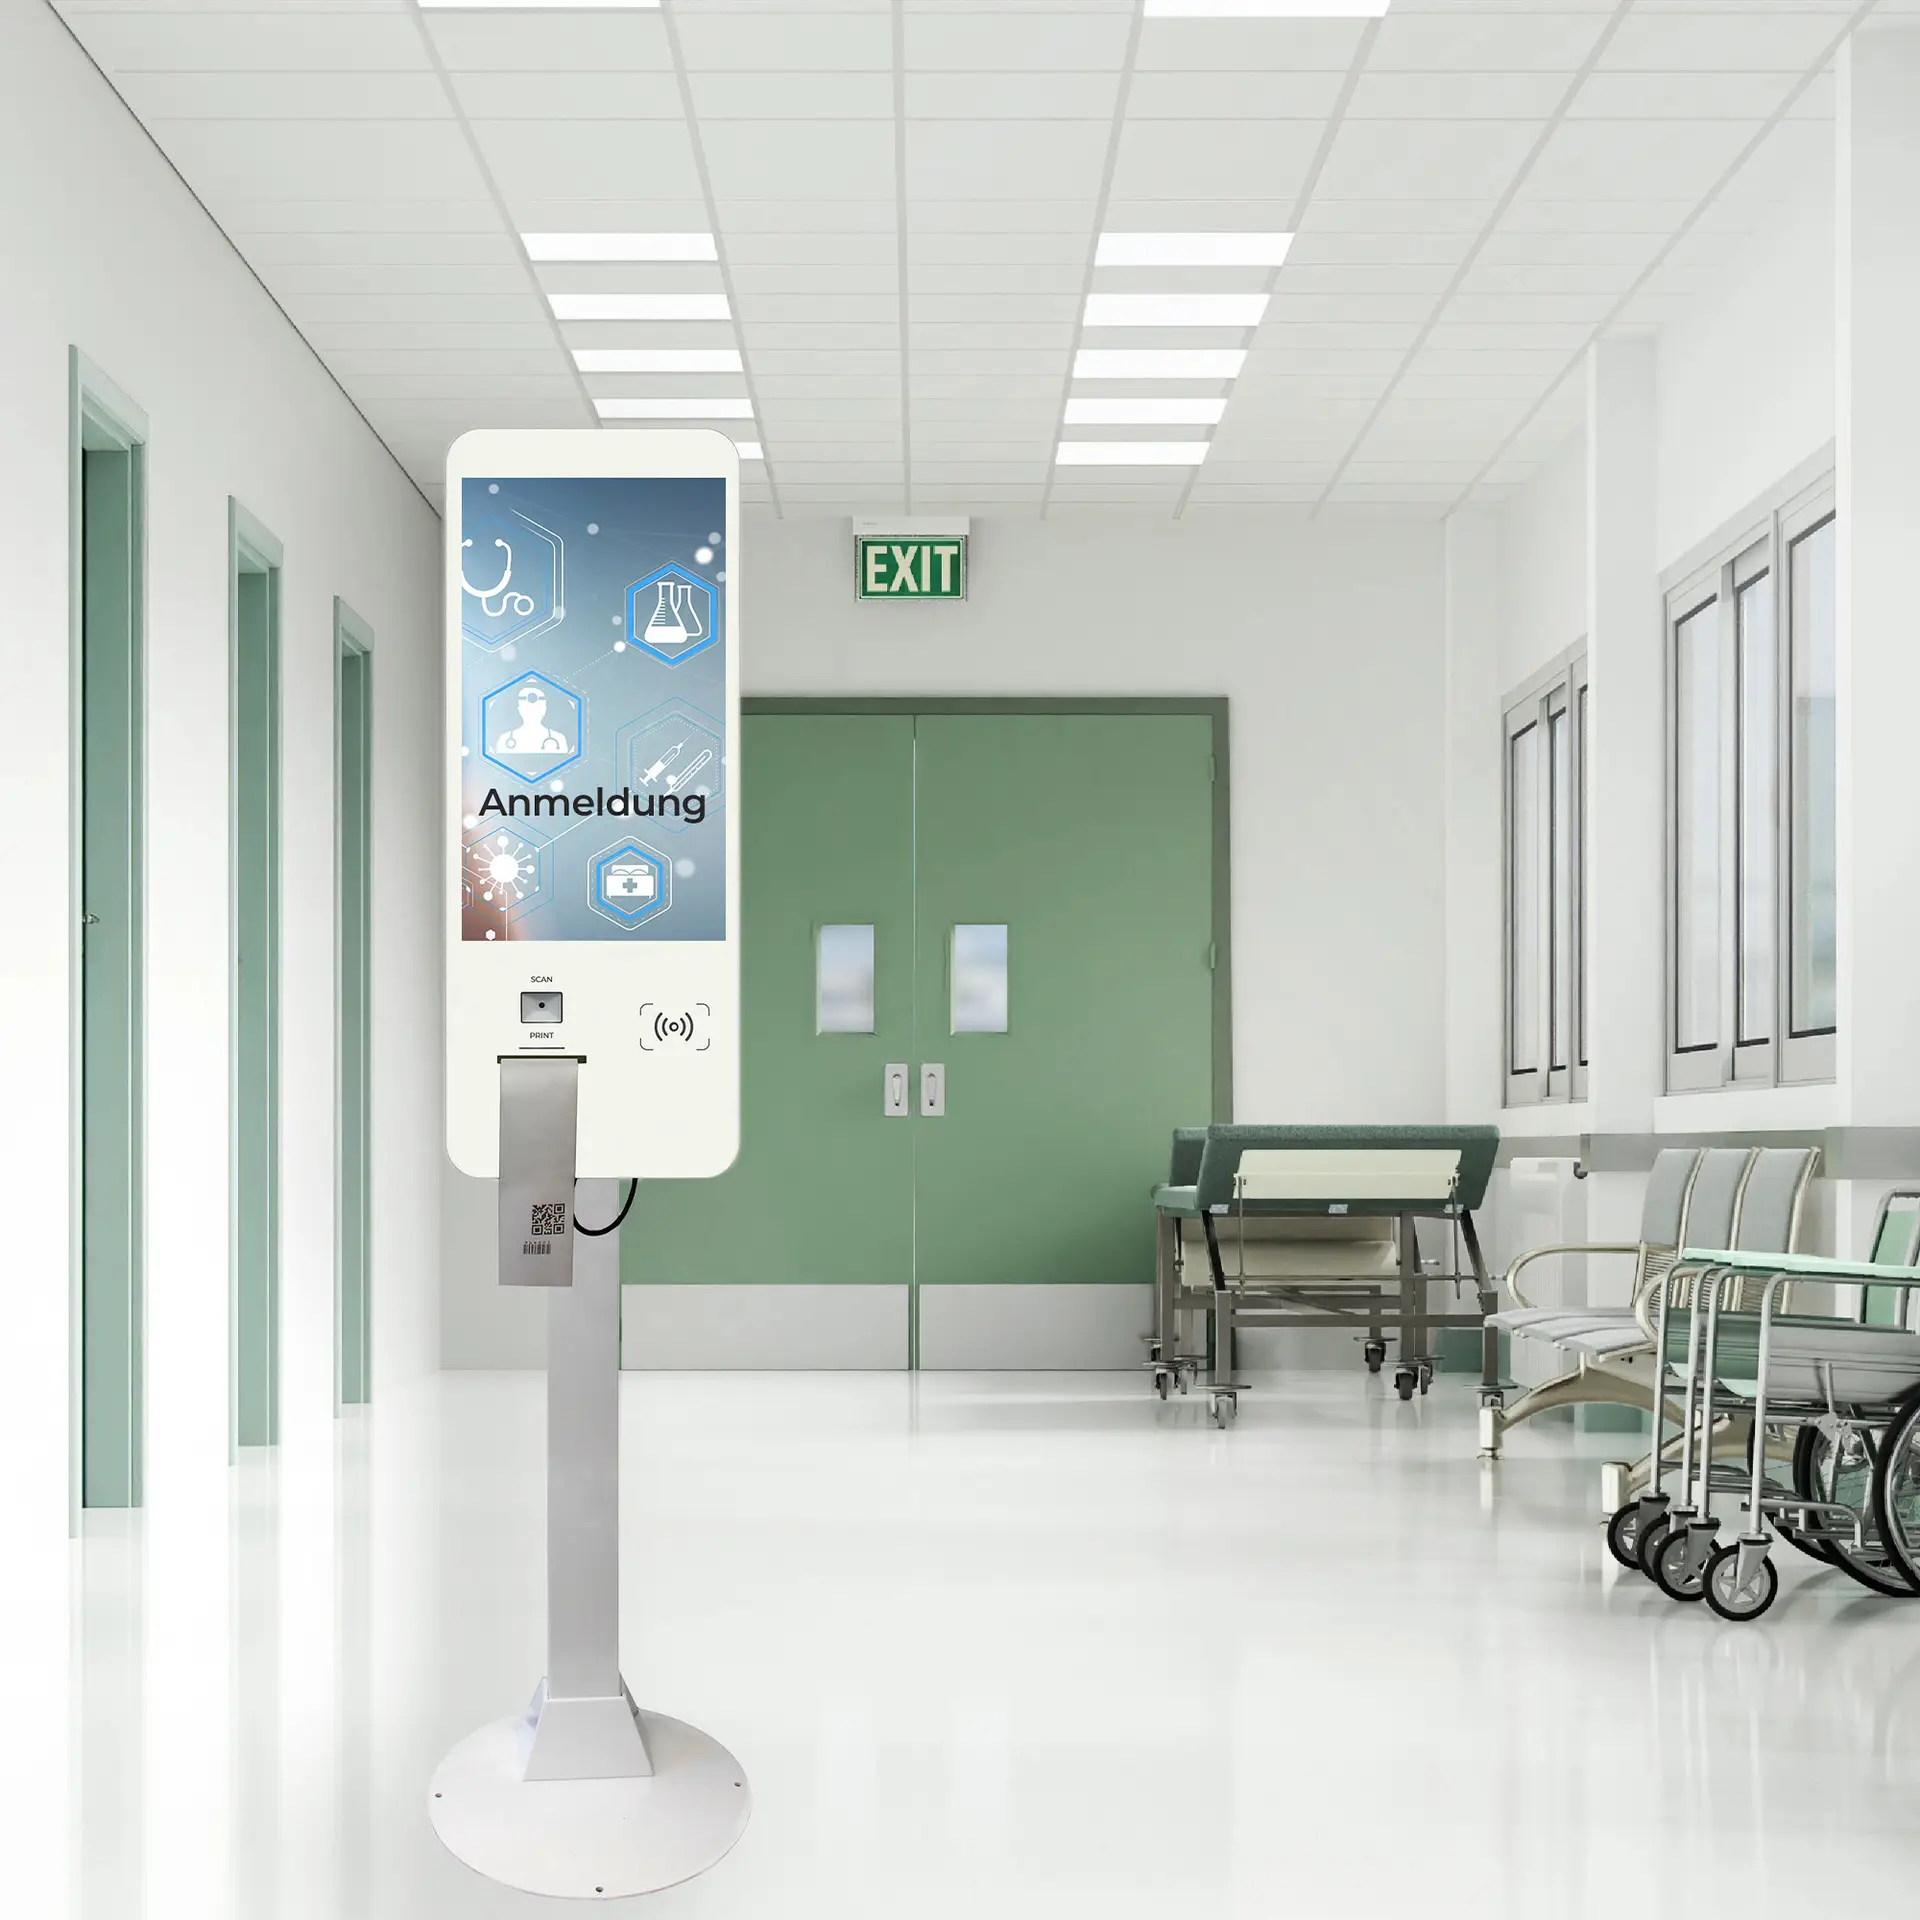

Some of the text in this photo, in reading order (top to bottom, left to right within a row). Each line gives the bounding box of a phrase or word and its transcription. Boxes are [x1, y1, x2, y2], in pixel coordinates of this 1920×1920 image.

[866, 545, 958, 592] EXIT
[478, 786, 706, 824] Anmeldung
[530, 975, 553, 984] SCAN
[529, 1031, 555, 1040] PRINT
